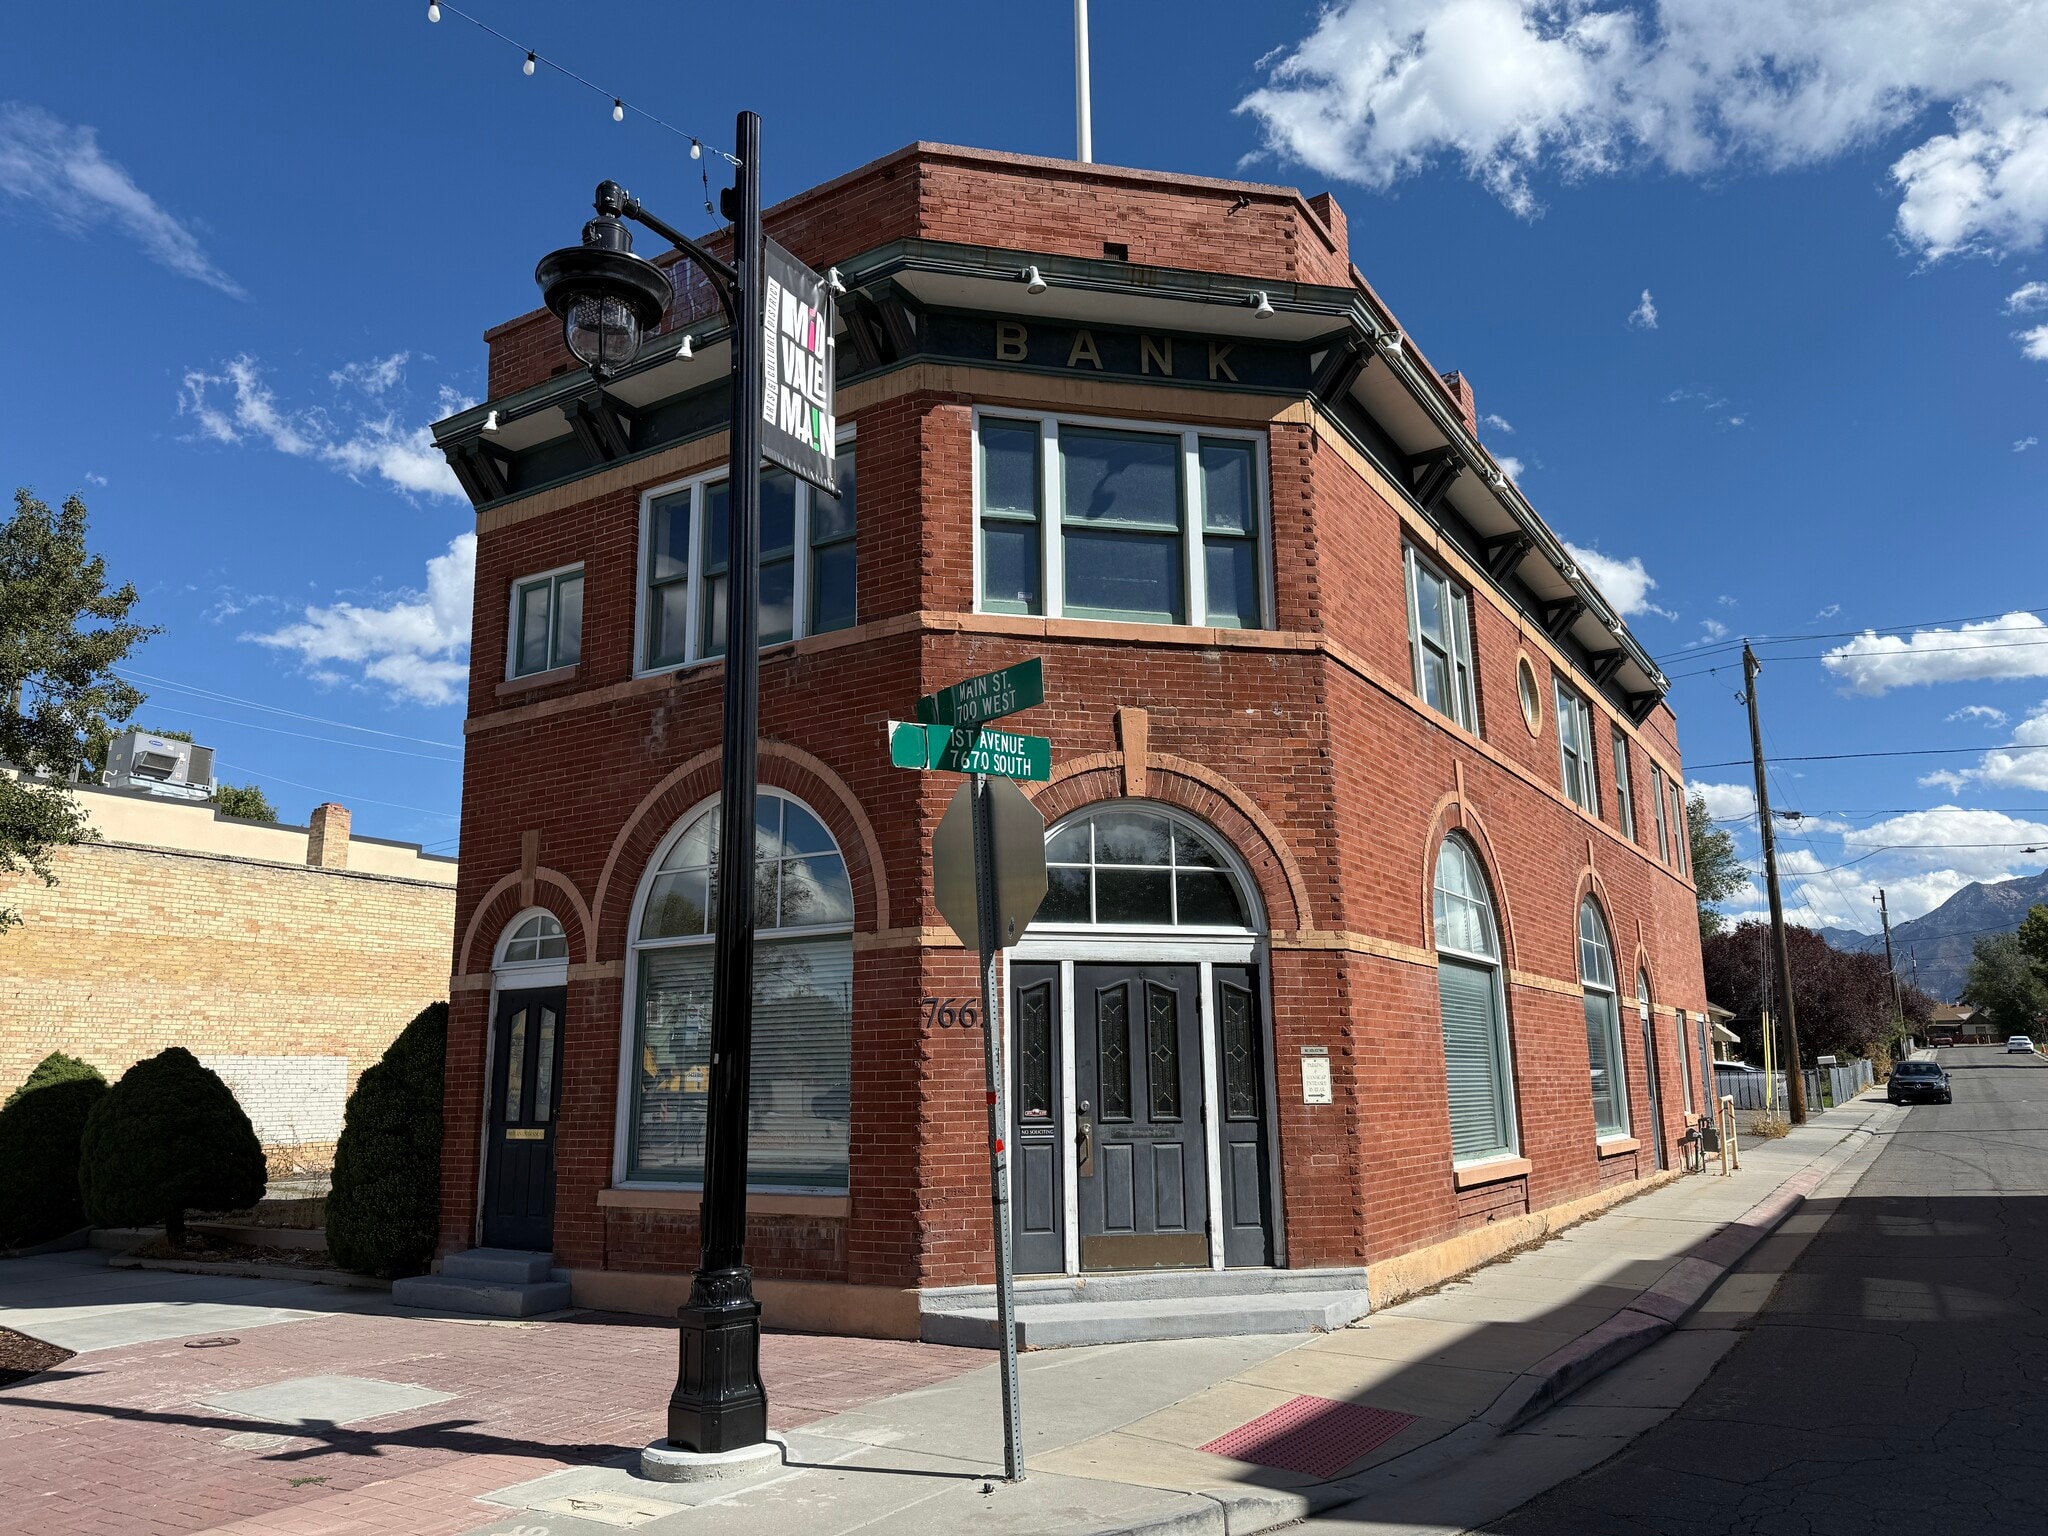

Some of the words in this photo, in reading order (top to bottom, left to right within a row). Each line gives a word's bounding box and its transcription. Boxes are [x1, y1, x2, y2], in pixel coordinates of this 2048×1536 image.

[767, 282, 779, 328] DISTRICT
[766, 334, 776, 378] CULTURE
[996, 320, 1239, 382] BANK
[765, 395, 775, 421] ARTS
[959, 676, 988, 702] MAIN
[992, 671, 1012, 692] ST.
[956, 701, 978, 724] 700
[982, 689, 1016, 716] WEST
[951, 728, 974, 748] 1ST
[979, 731, 1025, 756] AVENUE
[950, 749, 990, 770] 7670
[993, 753, 1032, 776] SOUTH
[921, 997, 984, 1029] 766
